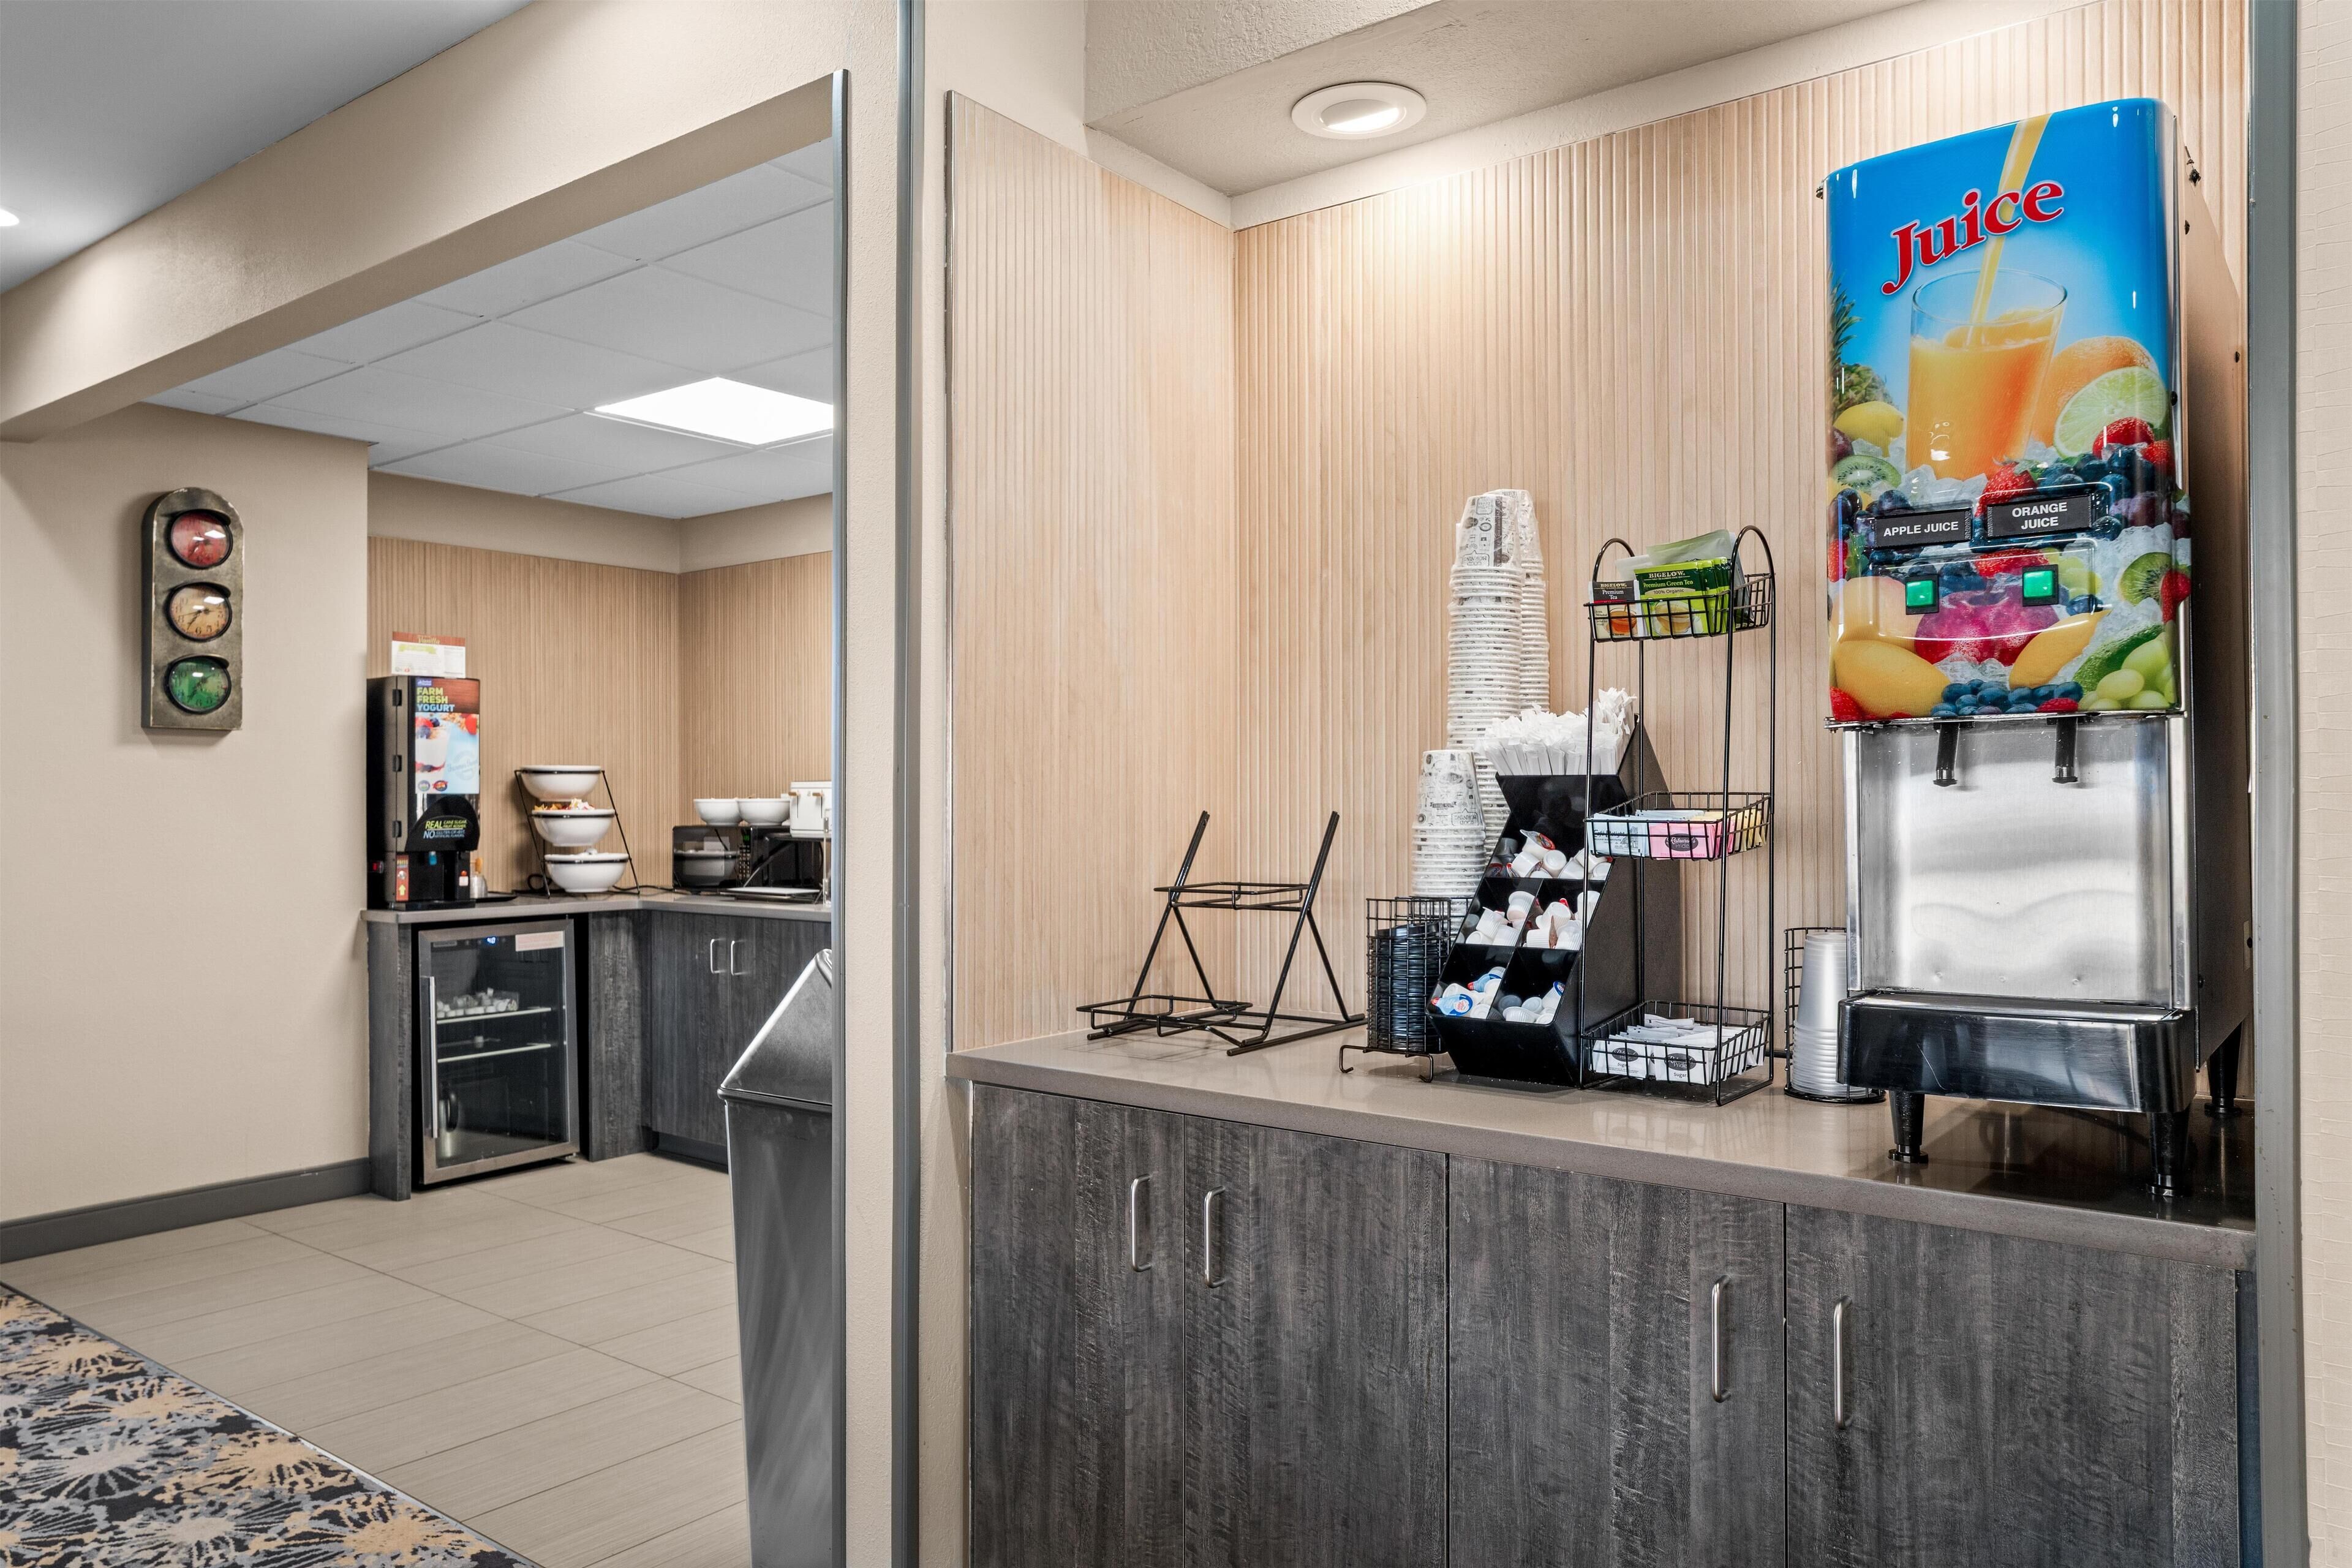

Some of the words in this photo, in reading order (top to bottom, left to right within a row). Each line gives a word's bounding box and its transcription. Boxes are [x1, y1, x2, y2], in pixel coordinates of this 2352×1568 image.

[1882, 181, 2064, 295] Juice
[2011, 502, 2068, 518] ORANGE
[1883, 524, 1921, 537] APPLE
[1924, 521, 1959, 533] JUICE
[2021, 516, 2059, 529] JUICE
[417, 687, 443, 695] FARM
[425, 820, 442, 829] REAL
[423, 830, 435, 839] NO
